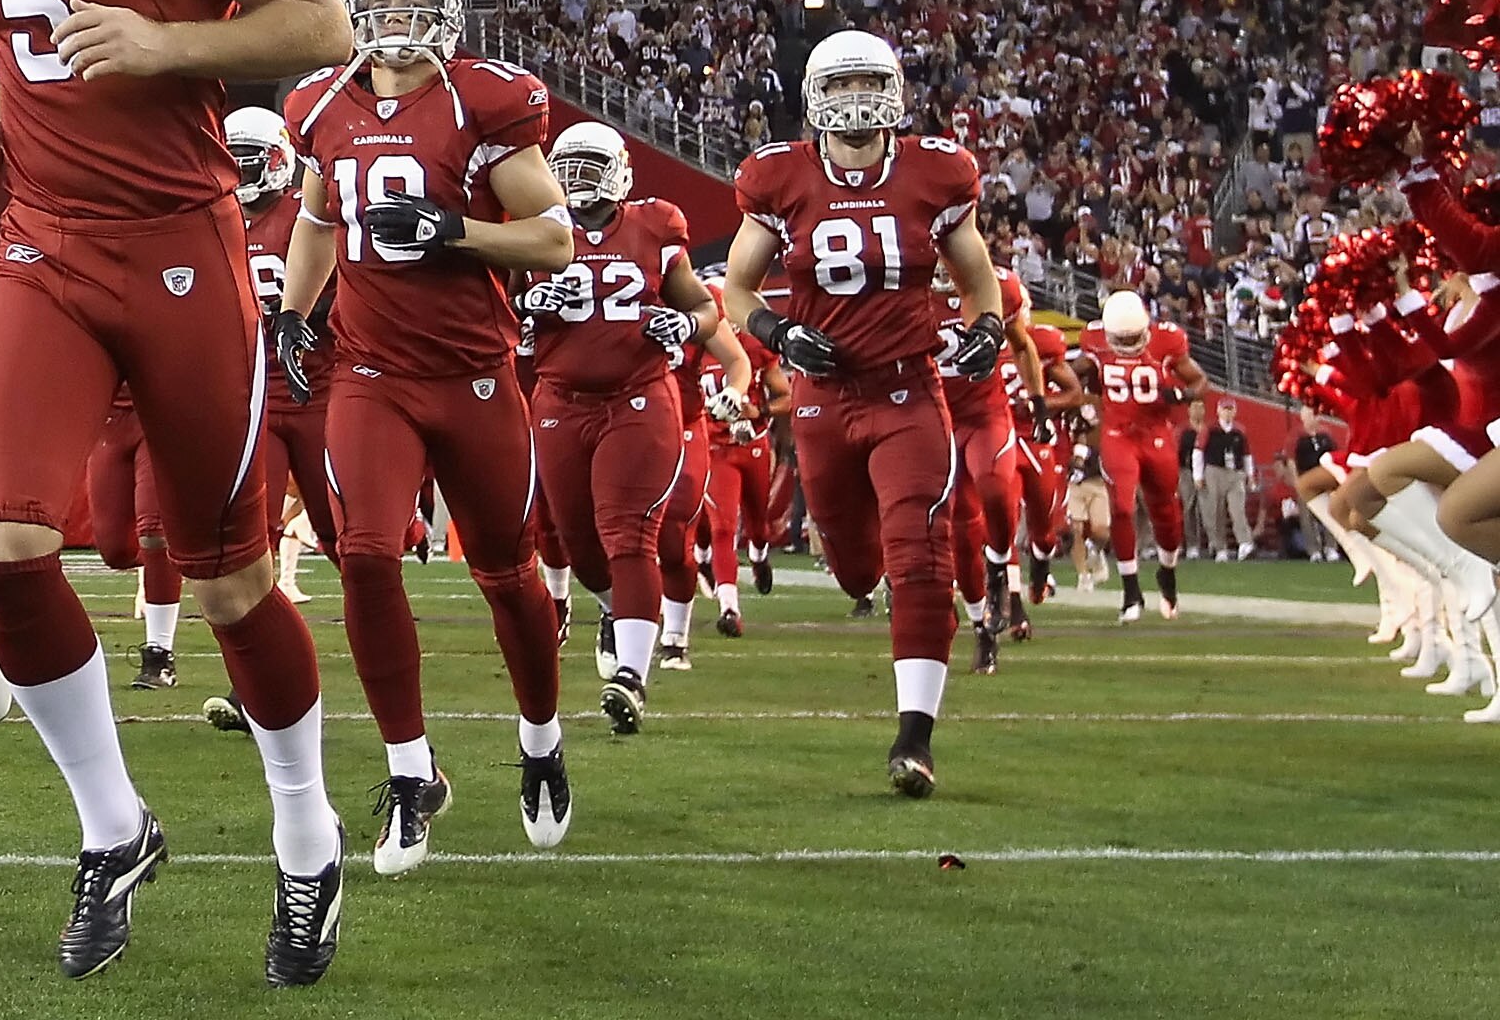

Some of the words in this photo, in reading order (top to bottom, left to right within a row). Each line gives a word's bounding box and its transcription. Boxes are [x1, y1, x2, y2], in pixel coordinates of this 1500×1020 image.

[353, 134, 414, 146] CARDINALS
[829, 199, 886, 211] CARDINALS
[812, 215, 902, 297] 81
[1103, 365, 1159, 405] 50
